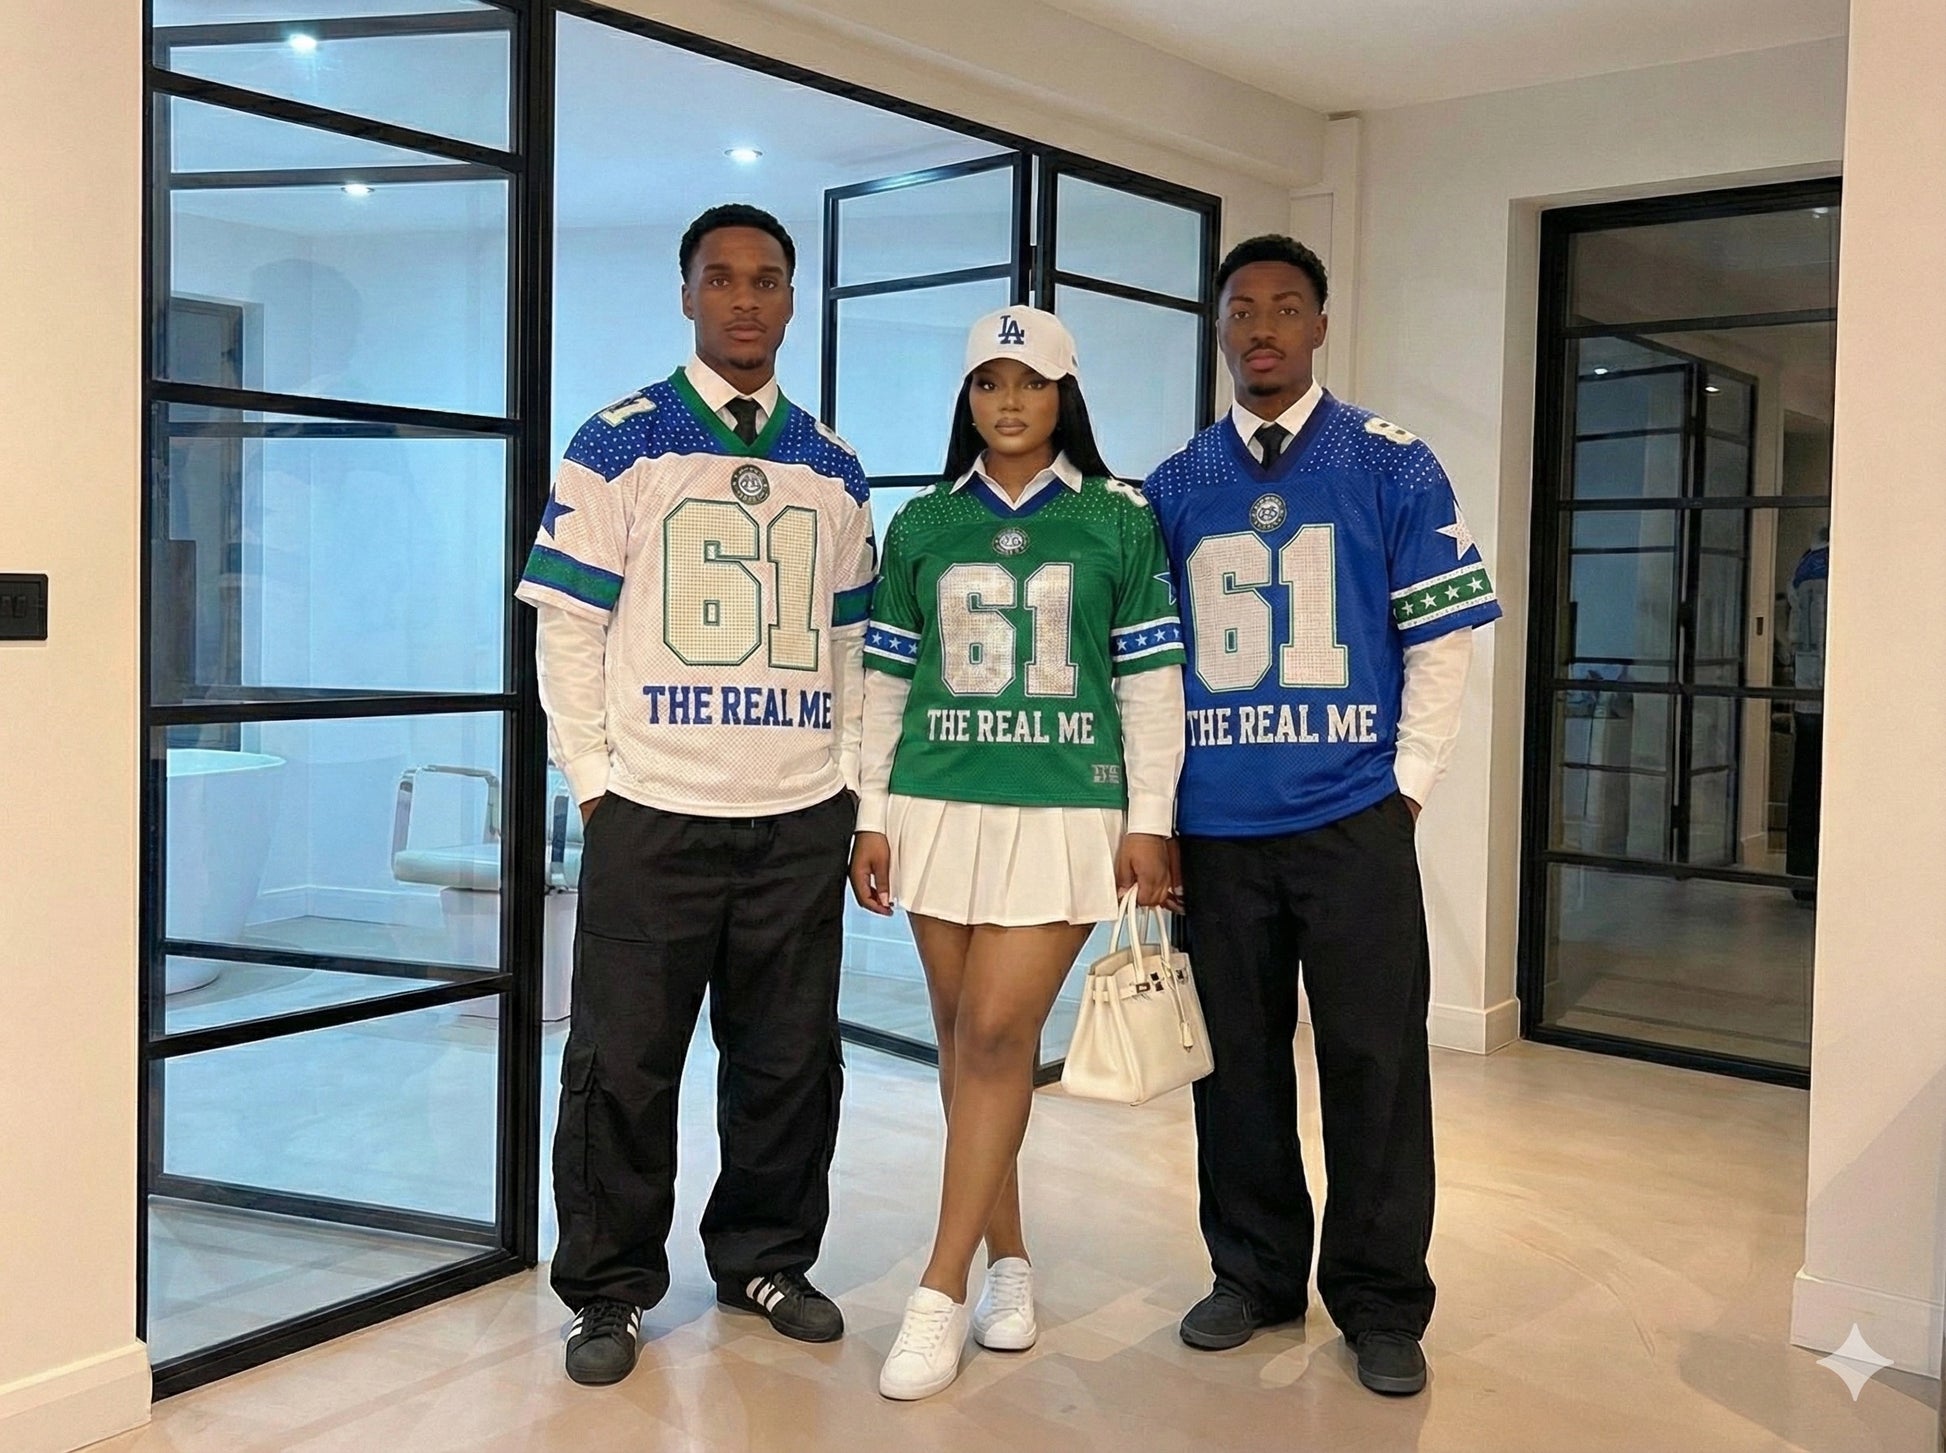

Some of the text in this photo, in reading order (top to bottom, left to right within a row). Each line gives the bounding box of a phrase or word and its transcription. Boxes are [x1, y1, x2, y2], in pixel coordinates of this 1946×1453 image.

[998, 315, 1025, 345] LA
[663, 498, 820, 672] 61
[937, 562, 1079, 699] 61
[1186, 523, 1349, 693] 61
[643, 685, 832, 730] THE REAL ME
[927, 709, 1095, 745] THE REAL ME
[1187, 704, 1377, 747] THE REAL ME
